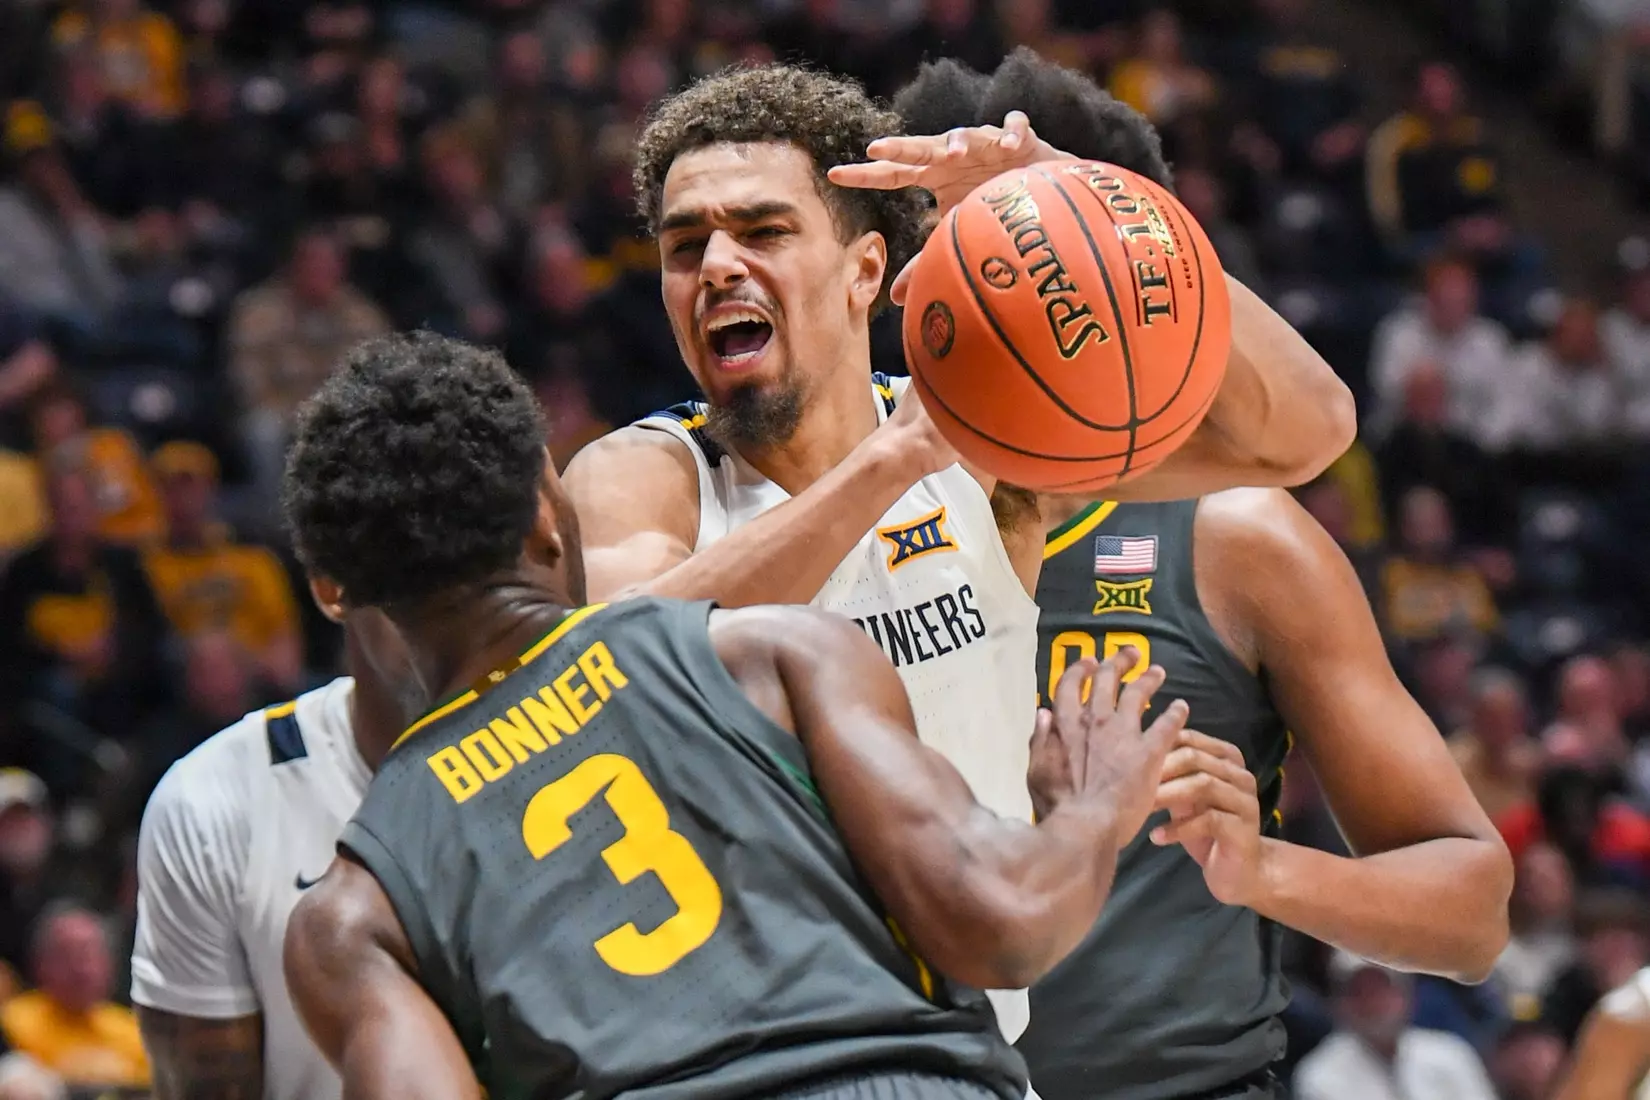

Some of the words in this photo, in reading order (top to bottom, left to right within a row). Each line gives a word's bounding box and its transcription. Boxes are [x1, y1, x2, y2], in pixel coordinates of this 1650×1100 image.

[982, 173, 1110, 360] SPALDING
[1062, 164, 1172, 327] TF-1000
[1181, 257, 1193, 289] DEEP
[880, 510, 955, 568] XII
[1097, 582, 1147, 610] XII
[850, 583, 986, 667] INEERS
[426, 640, 629, 804] BONNER
[522, 753, 723, 976] 3
